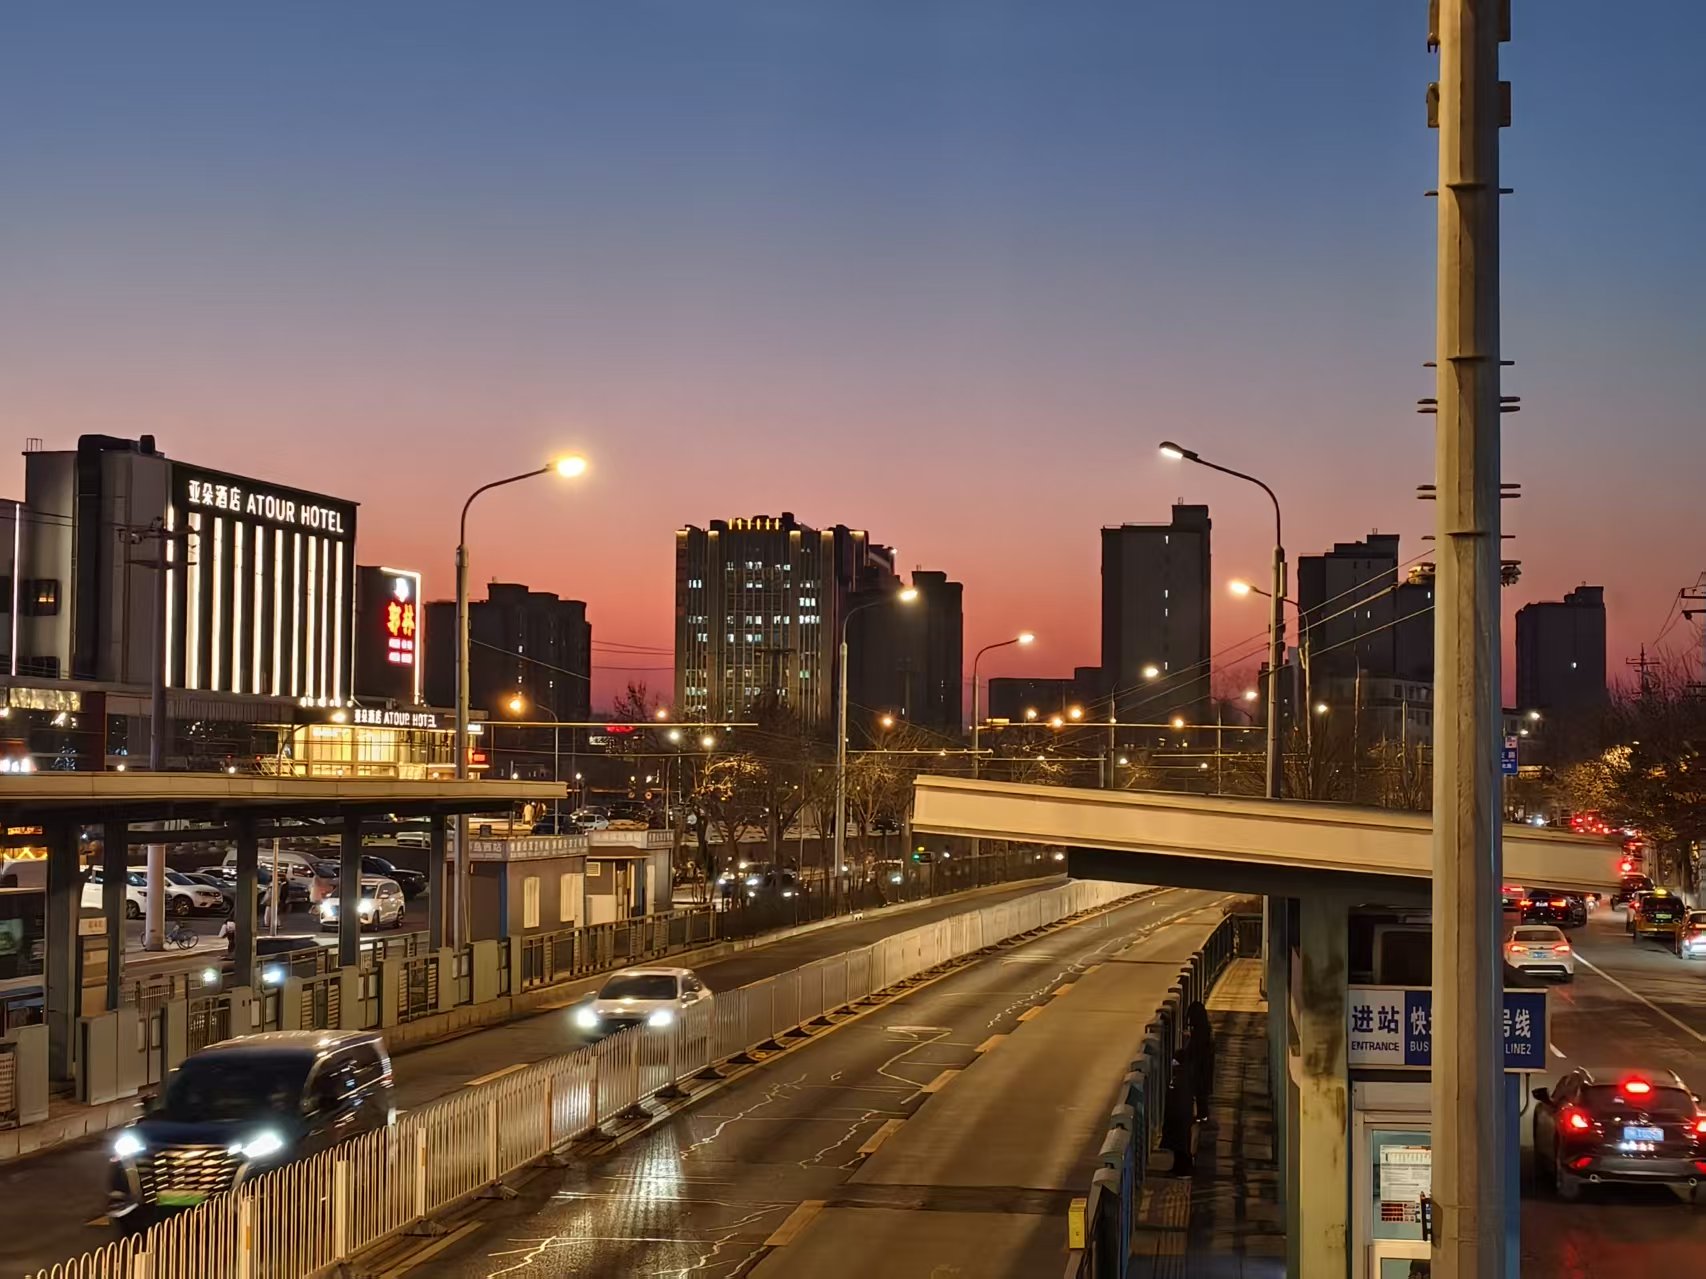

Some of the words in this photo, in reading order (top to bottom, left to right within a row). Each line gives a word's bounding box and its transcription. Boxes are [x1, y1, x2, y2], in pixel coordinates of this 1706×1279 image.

[188, 480, 241, 512] 亚朵酒店
[246, 493, 295, 523] ATOUR
[301, 504, 344, 533] HOTEL
[412, 713, 437, 728] HOTEL
[1351, 1005, 1400, 1035] 进站
[1410, 1006, 1432, 1037] 快
[1351, 1040, 1400, 1052] ENTRANCE
[1410, 1040, 1429, 1053] BUS
[1505, 1043, 1532, 1055] LINE2
